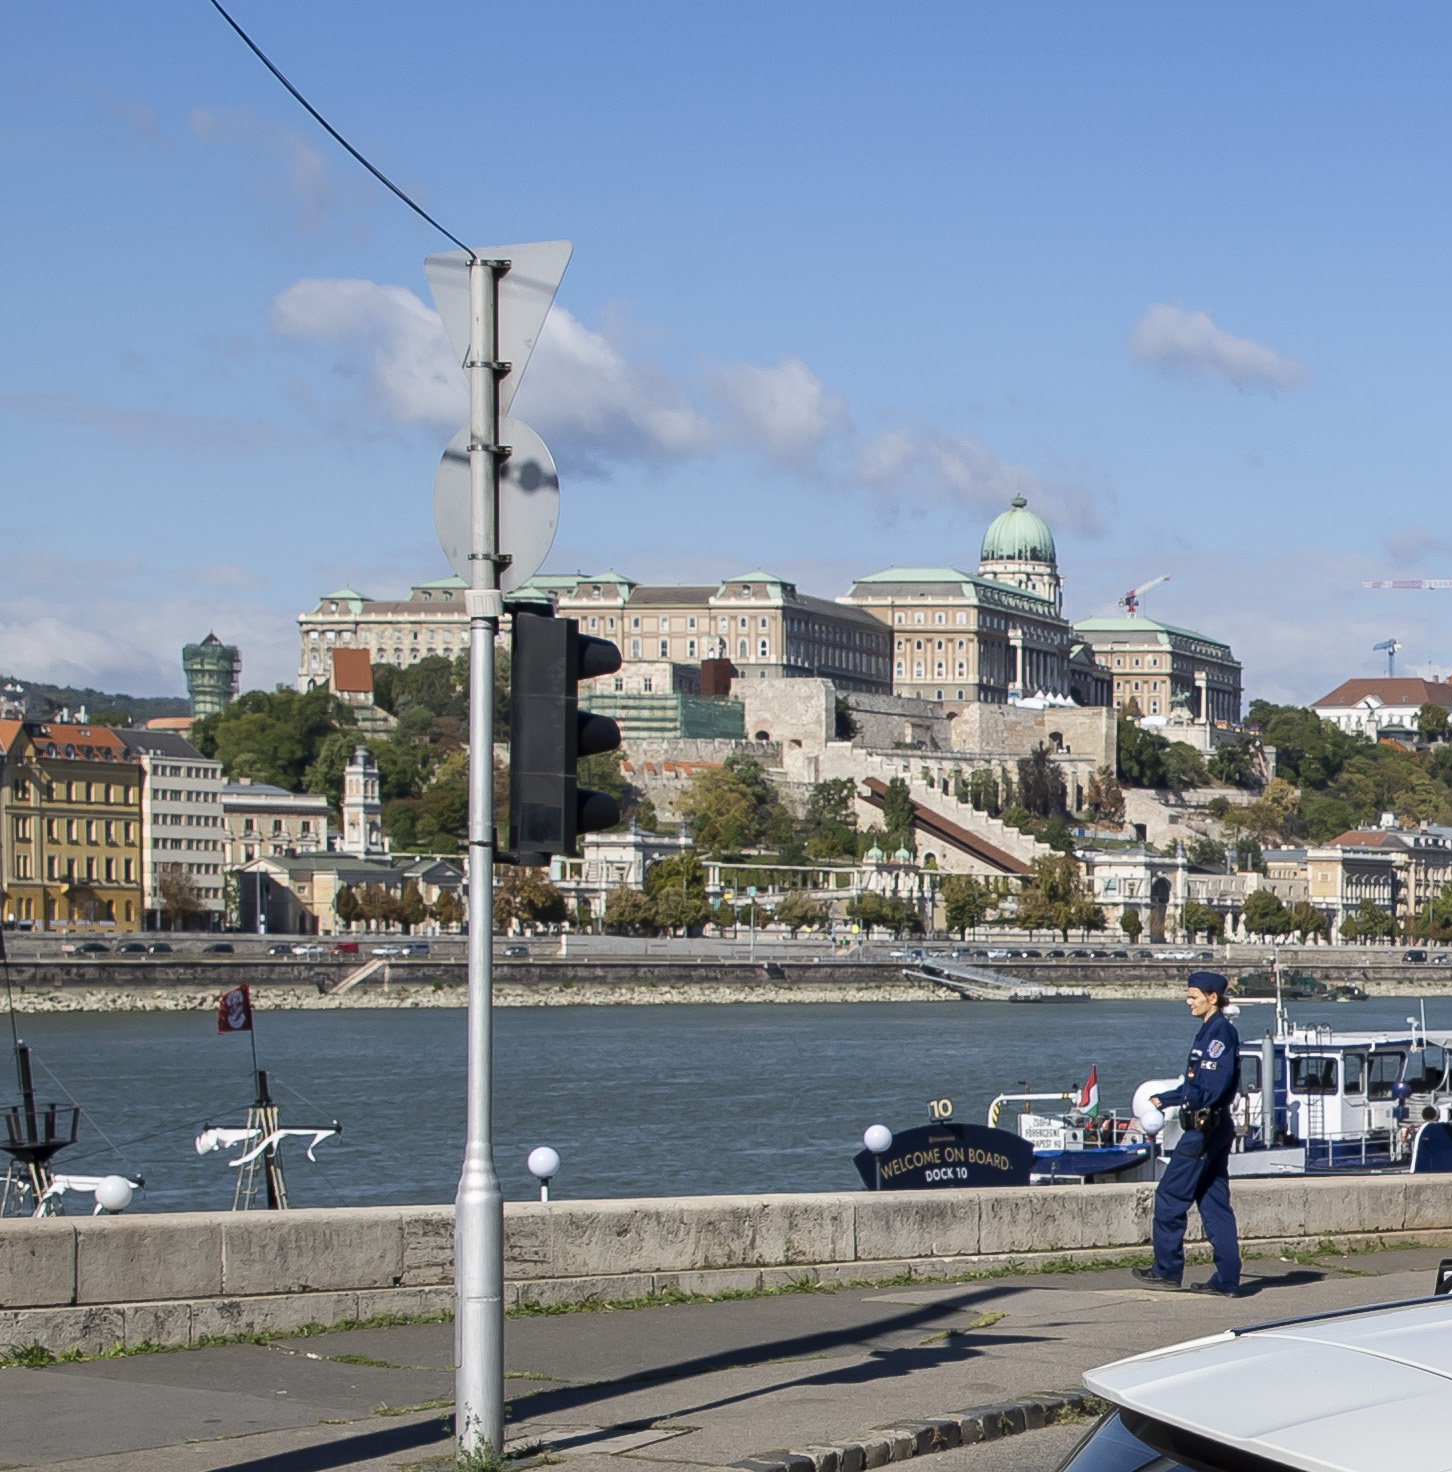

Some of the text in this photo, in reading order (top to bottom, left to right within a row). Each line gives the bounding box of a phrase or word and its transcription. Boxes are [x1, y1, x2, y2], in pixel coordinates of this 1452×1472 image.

[930, 1099, 952, 1118] 10
[881, 1148, 941, 1180] WELCOME
[944, 1147, 965, 1162] ON
[925, 1167, 968, 1182] DOCK 10
